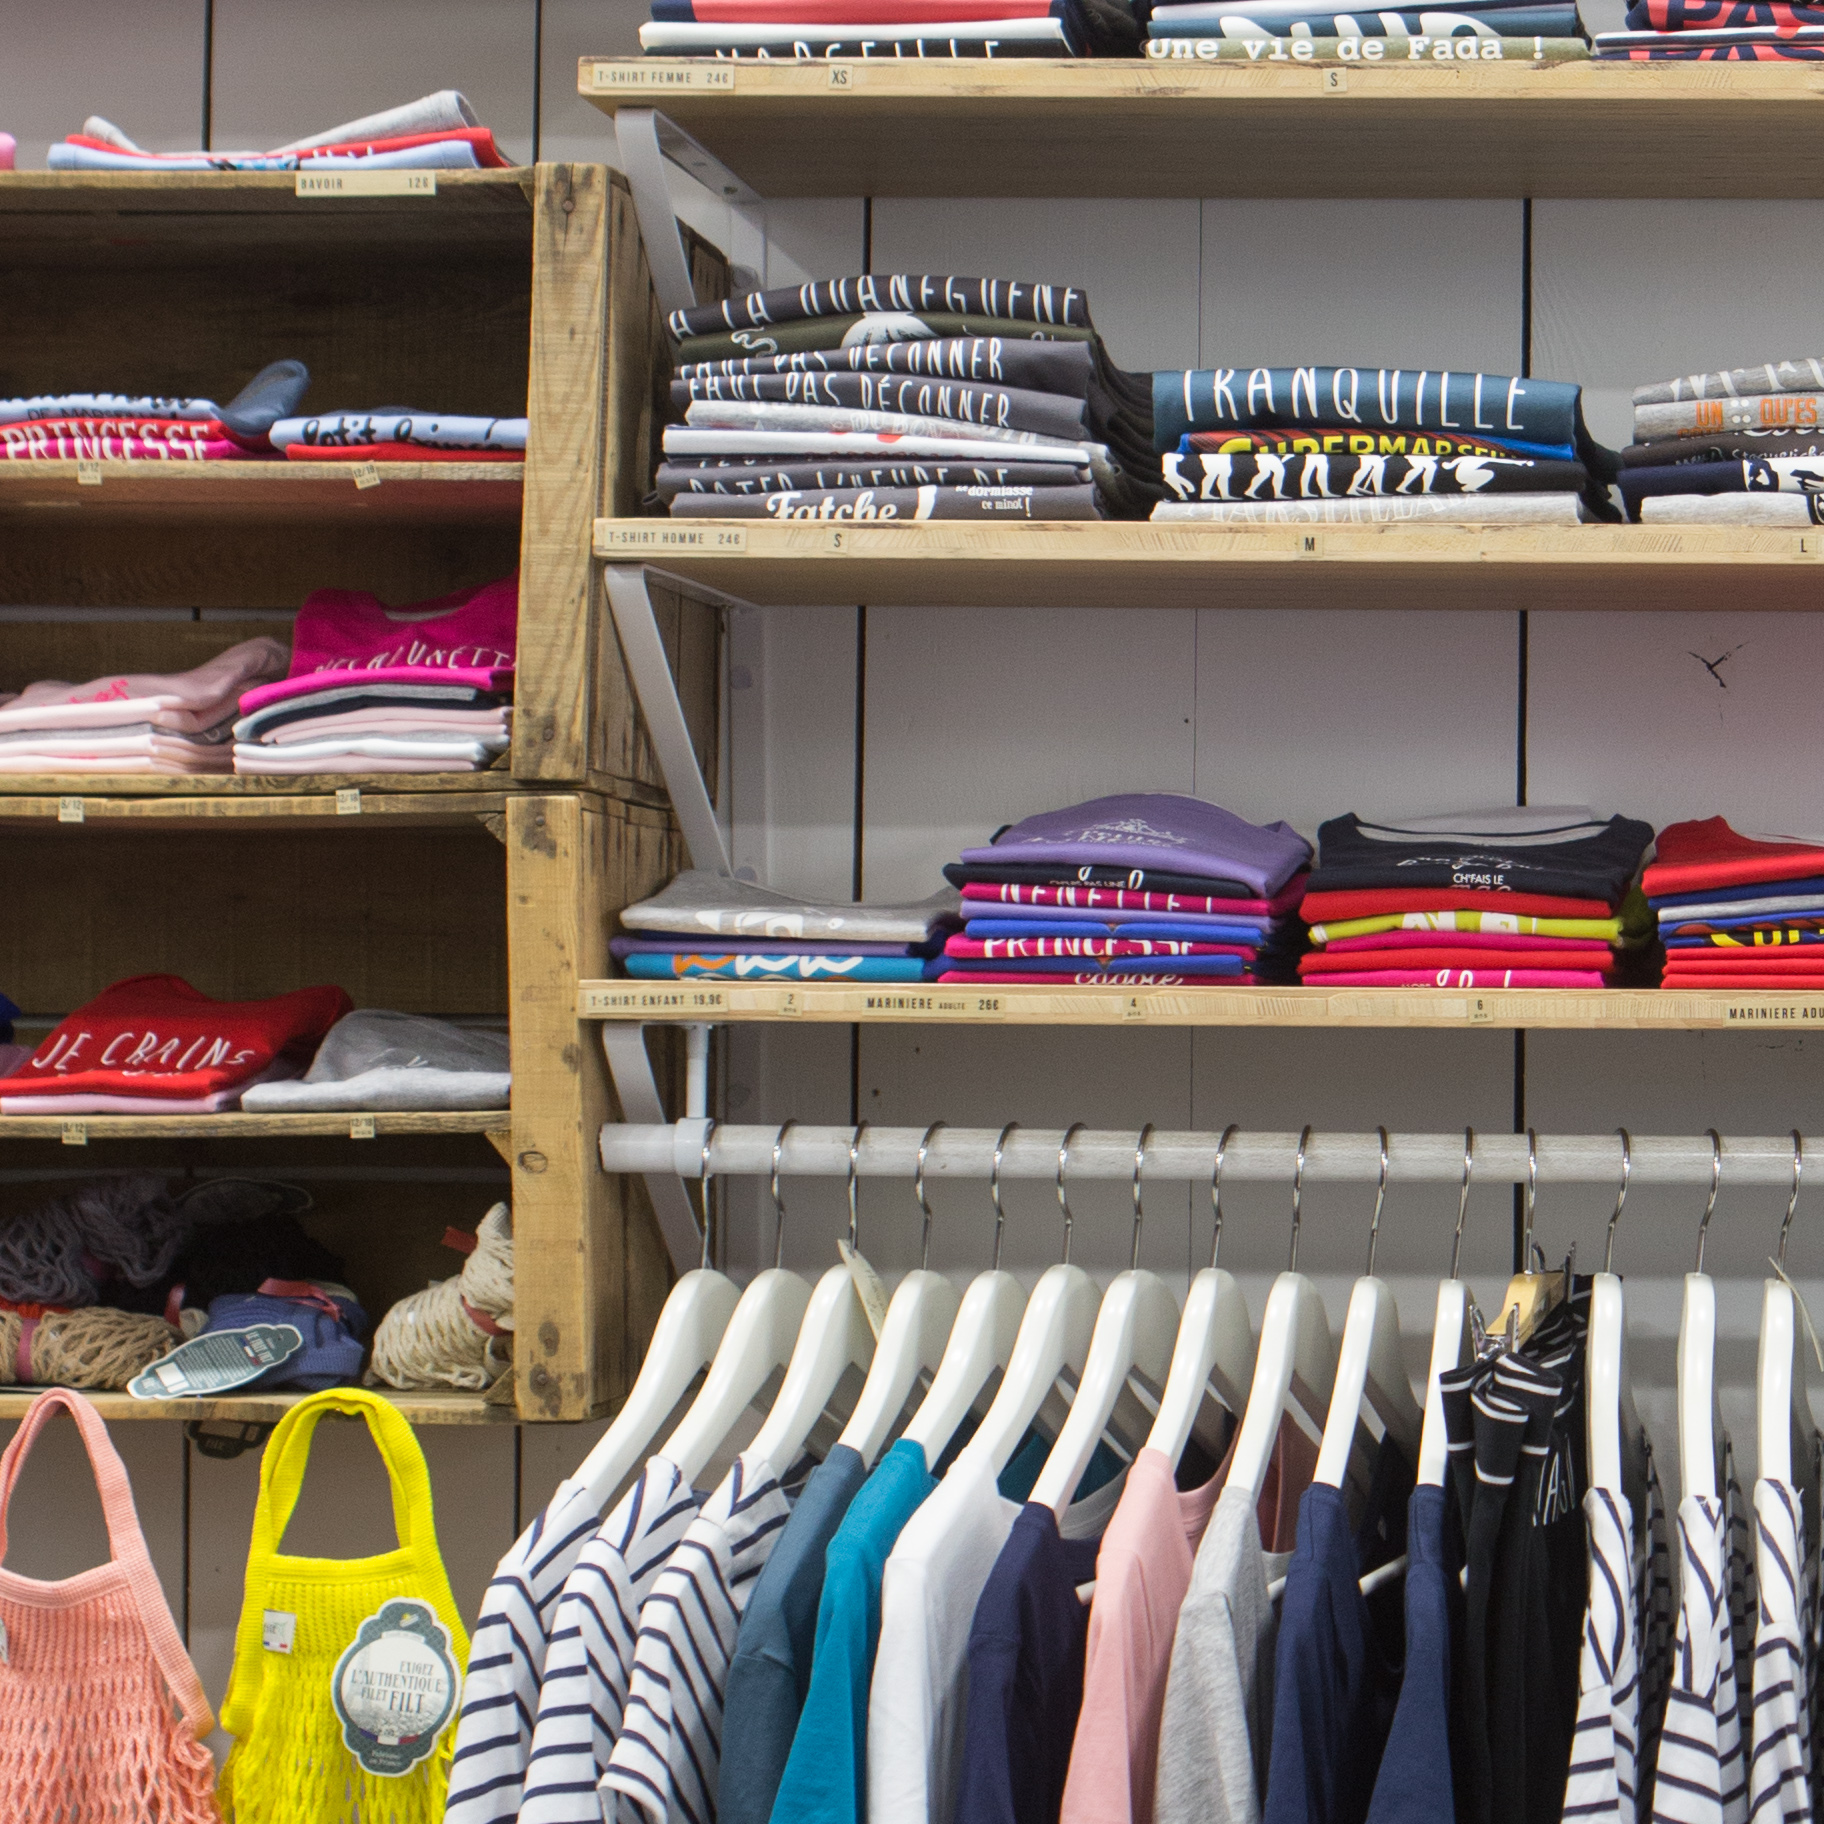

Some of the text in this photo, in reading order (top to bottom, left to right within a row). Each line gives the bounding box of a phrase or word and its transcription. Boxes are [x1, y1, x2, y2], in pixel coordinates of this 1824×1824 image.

[1147, 35, 1544, 61] Une vie de Fada !
[598, 71, 729, 84] T-SHIRT FEMME 24€
[831, 69, 848, 86] XS
[1330, 71, 1339, 87] S
[301, 178, 343, 190] BAVOIR
[1696, 396, 1818, 428] UN QU'ES
[609, 531, 741, 545] T-SHIRT HOMME 24€
[833, 533, 843, 548] S
[1304, 536, 1315, 552] M
[1800, 538, 1808, 554] L
[1493, 873, 1505, 886] LE
[592, 994, 685, 1007] T-SHIRT ENFANT
[787, 993, 795, 1004] 2
[867, 997, 933, 1010] MARINIERE
[1729, 1006, 1798, 1020] MARINIERE
[31, 1031, 256, 1071] JE CRAINS
[400, 1660, 435, 1676] EXIGEZ
[351, 1668, 442, 1694] L'AUTHENTIQUE
[361, 1687, 426, 1716] FILET FILT
